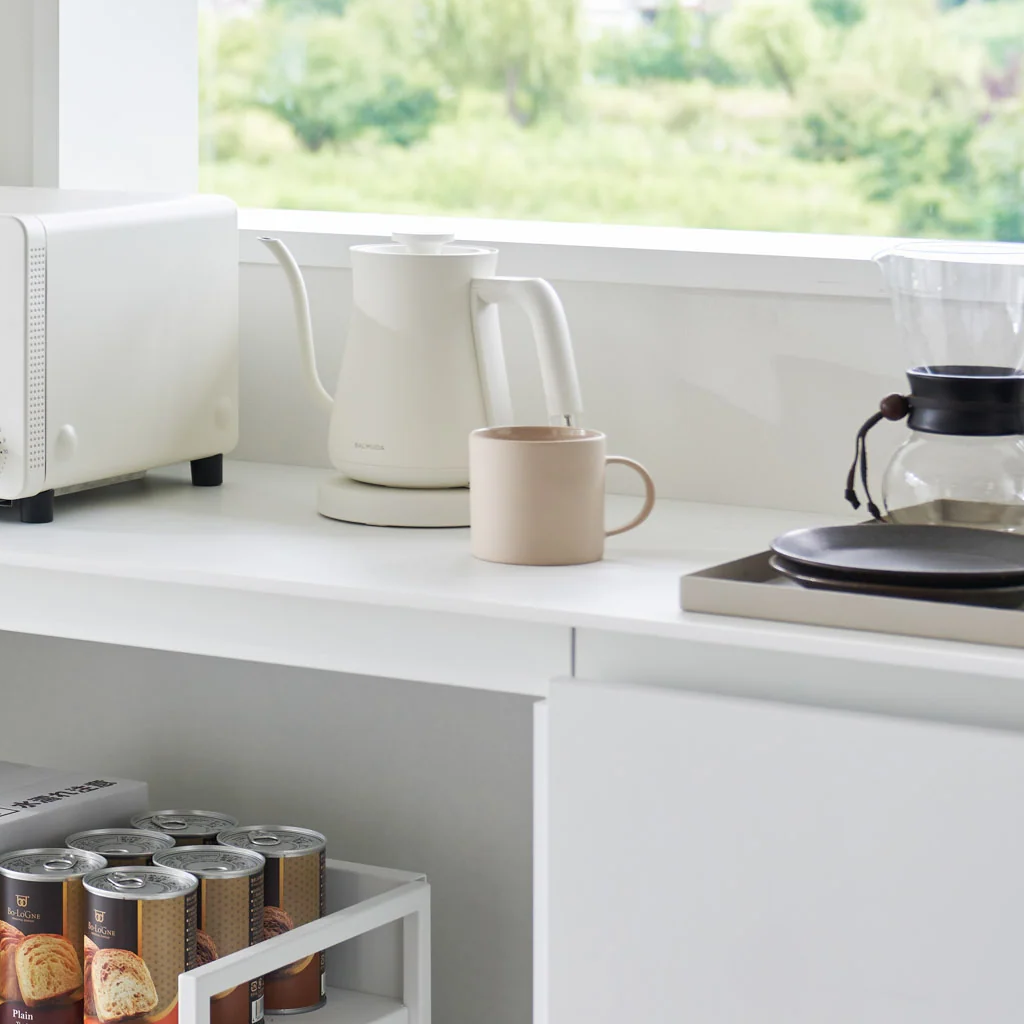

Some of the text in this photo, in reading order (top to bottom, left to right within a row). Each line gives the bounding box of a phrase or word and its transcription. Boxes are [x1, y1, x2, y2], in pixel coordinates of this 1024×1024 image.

[11, 779, 118, 809] 水濡れ注意
[12, 1008, 34, 1021] Plain
